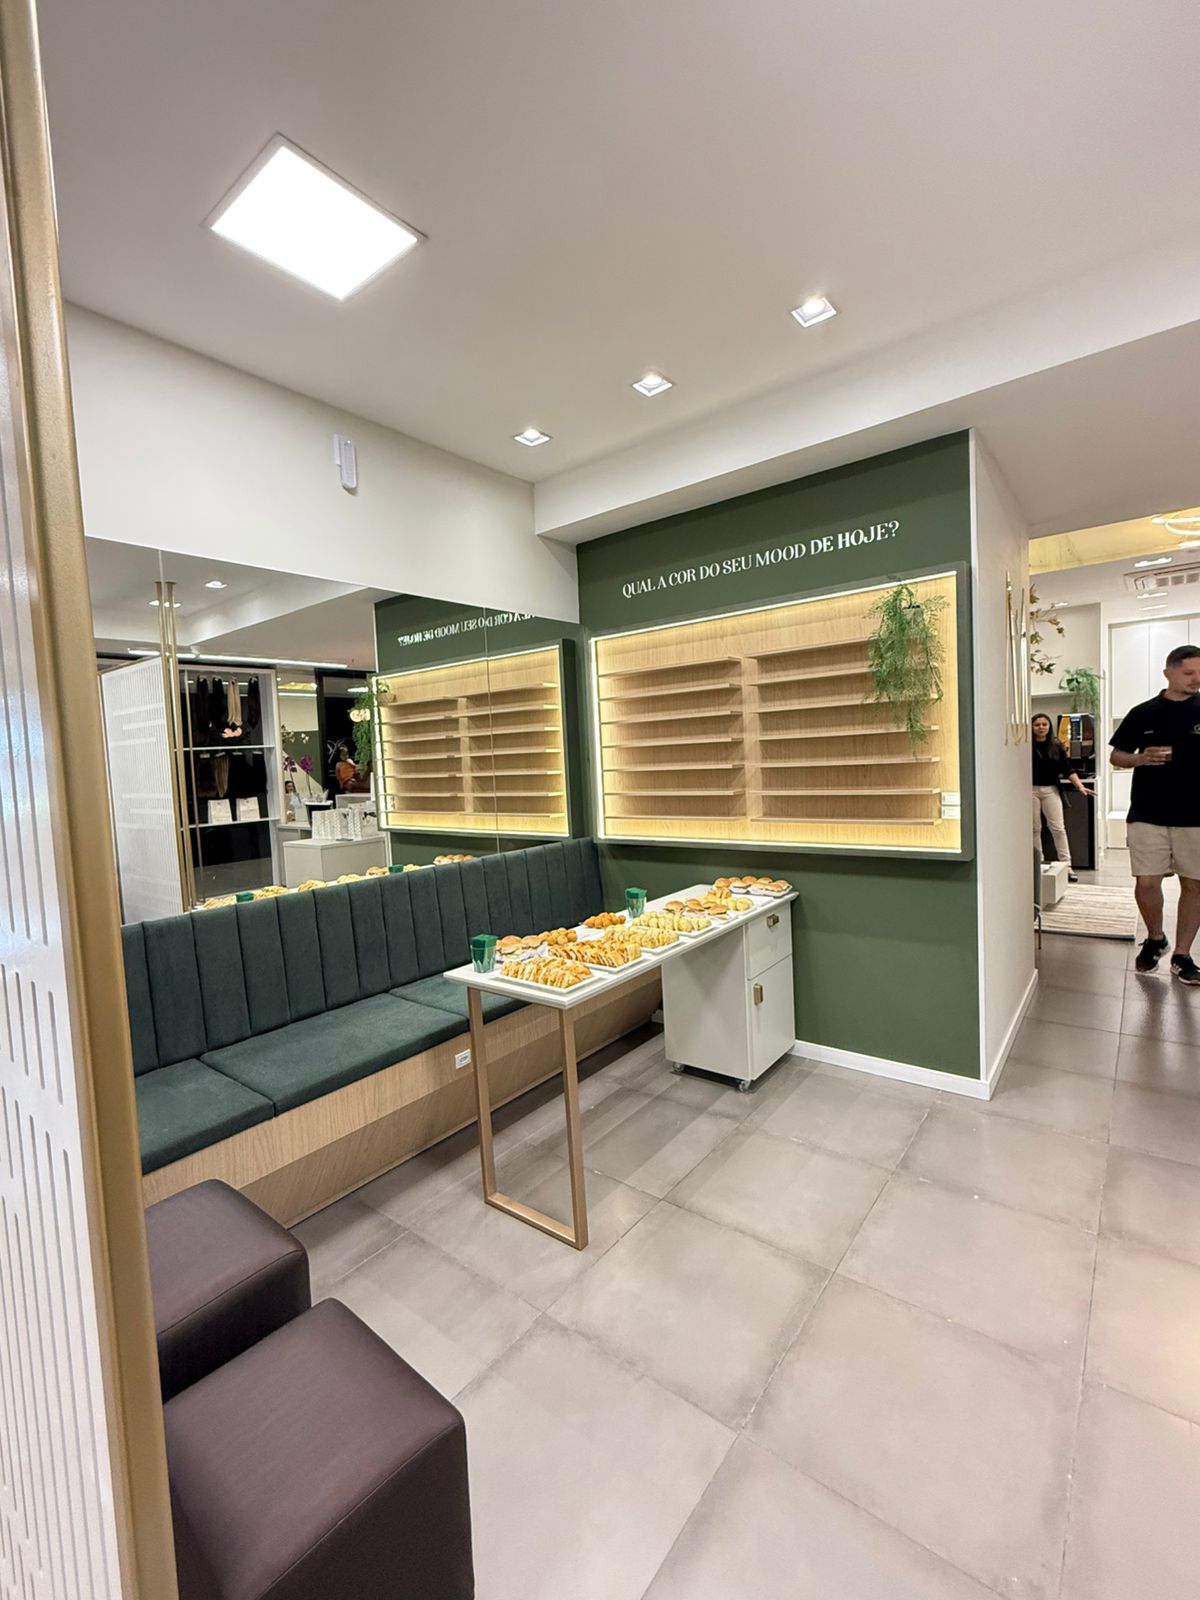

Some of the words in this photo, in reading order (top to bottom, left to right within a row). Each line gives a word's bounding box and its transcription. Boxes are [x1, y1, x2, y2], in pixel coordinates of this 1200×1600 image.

[622, 578, 656, 598] QUAL
[657, 575, 667, 589] A
[668, 568, 696, 586] COR
[699, 562, 720, 579] DO
[722, 554, 752, 574] SEU
[755, 543, 806, 567] MOOD
[810, 535, 834, 555] DE
[837, 520, 900, 549] HOJE?
